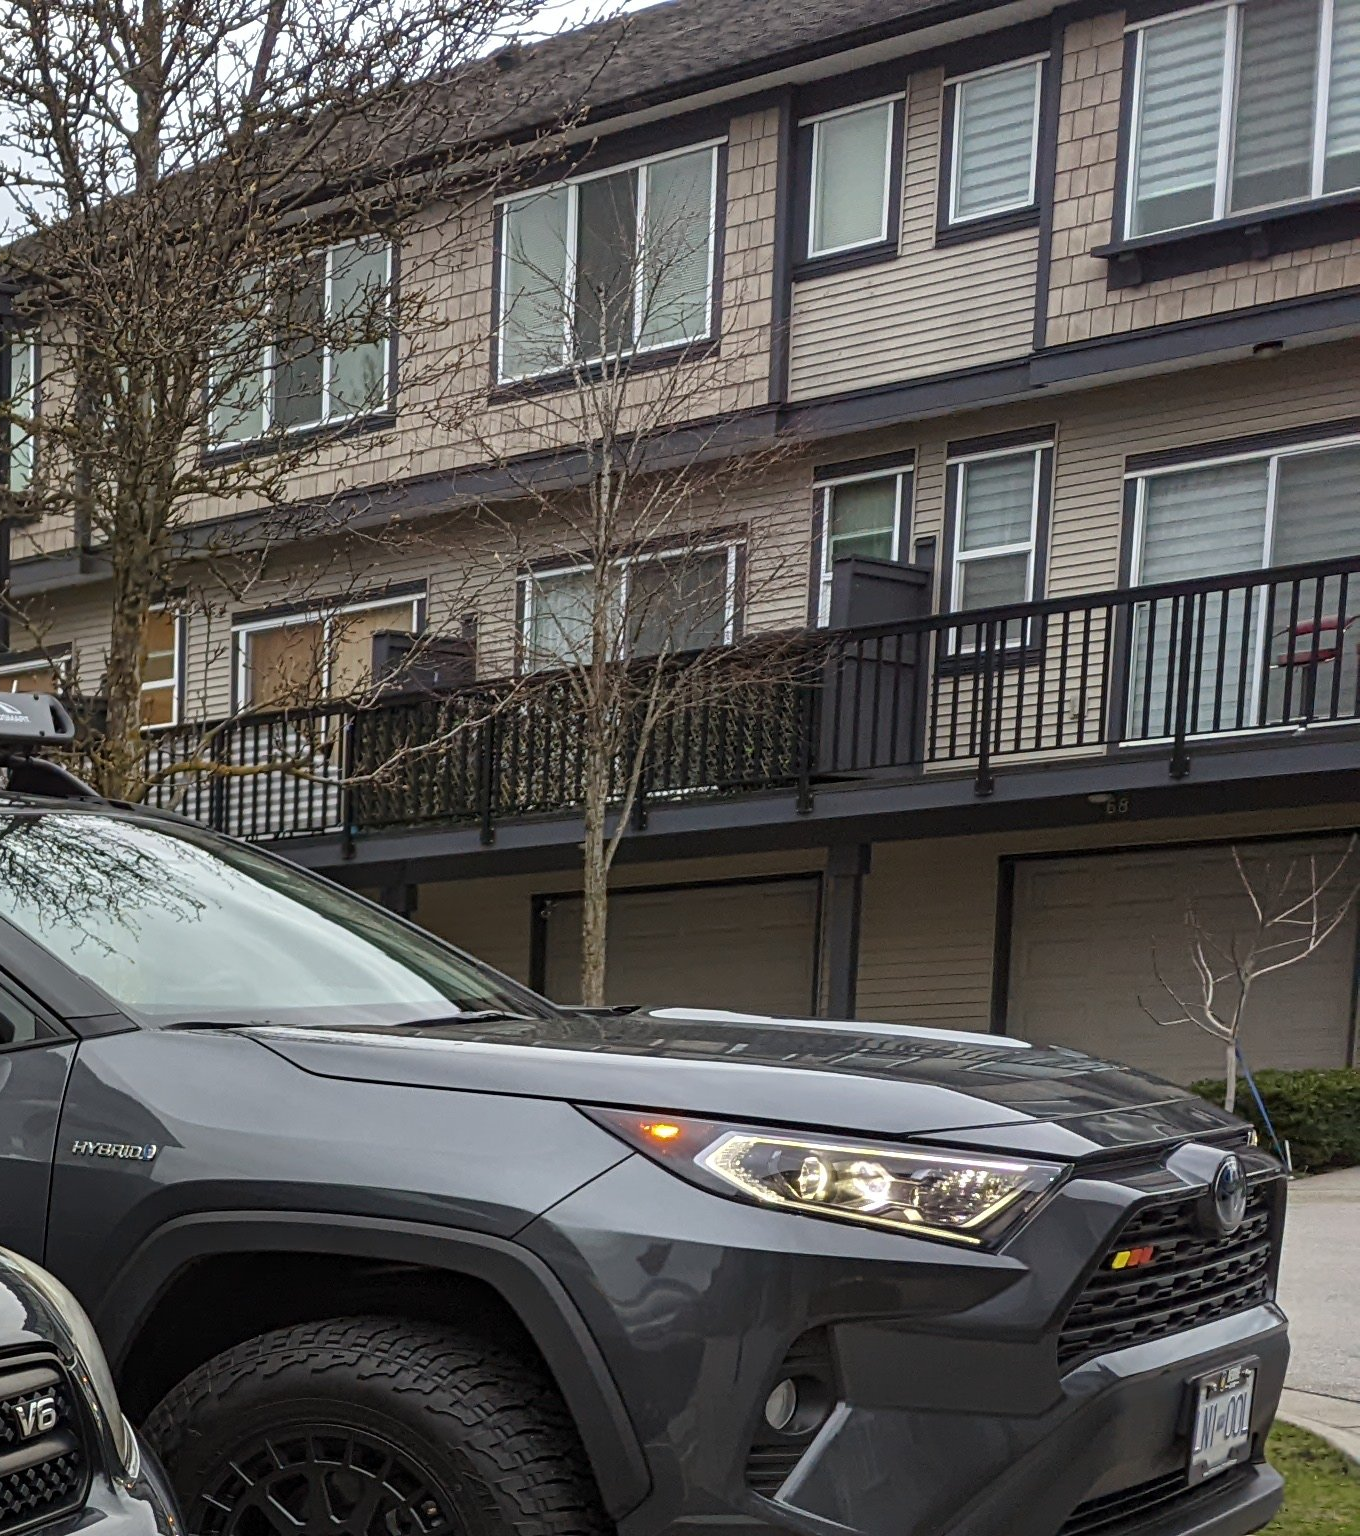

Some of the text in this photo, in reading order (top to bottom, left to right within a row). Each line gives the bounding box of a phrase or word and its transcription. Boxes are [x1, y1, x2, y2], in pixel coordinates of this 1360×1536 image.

[1105, 797, 1129, 814] 68
[71, 1140, 143, 1160] HYBRID
[15, 1397, 57, 1436] V6
